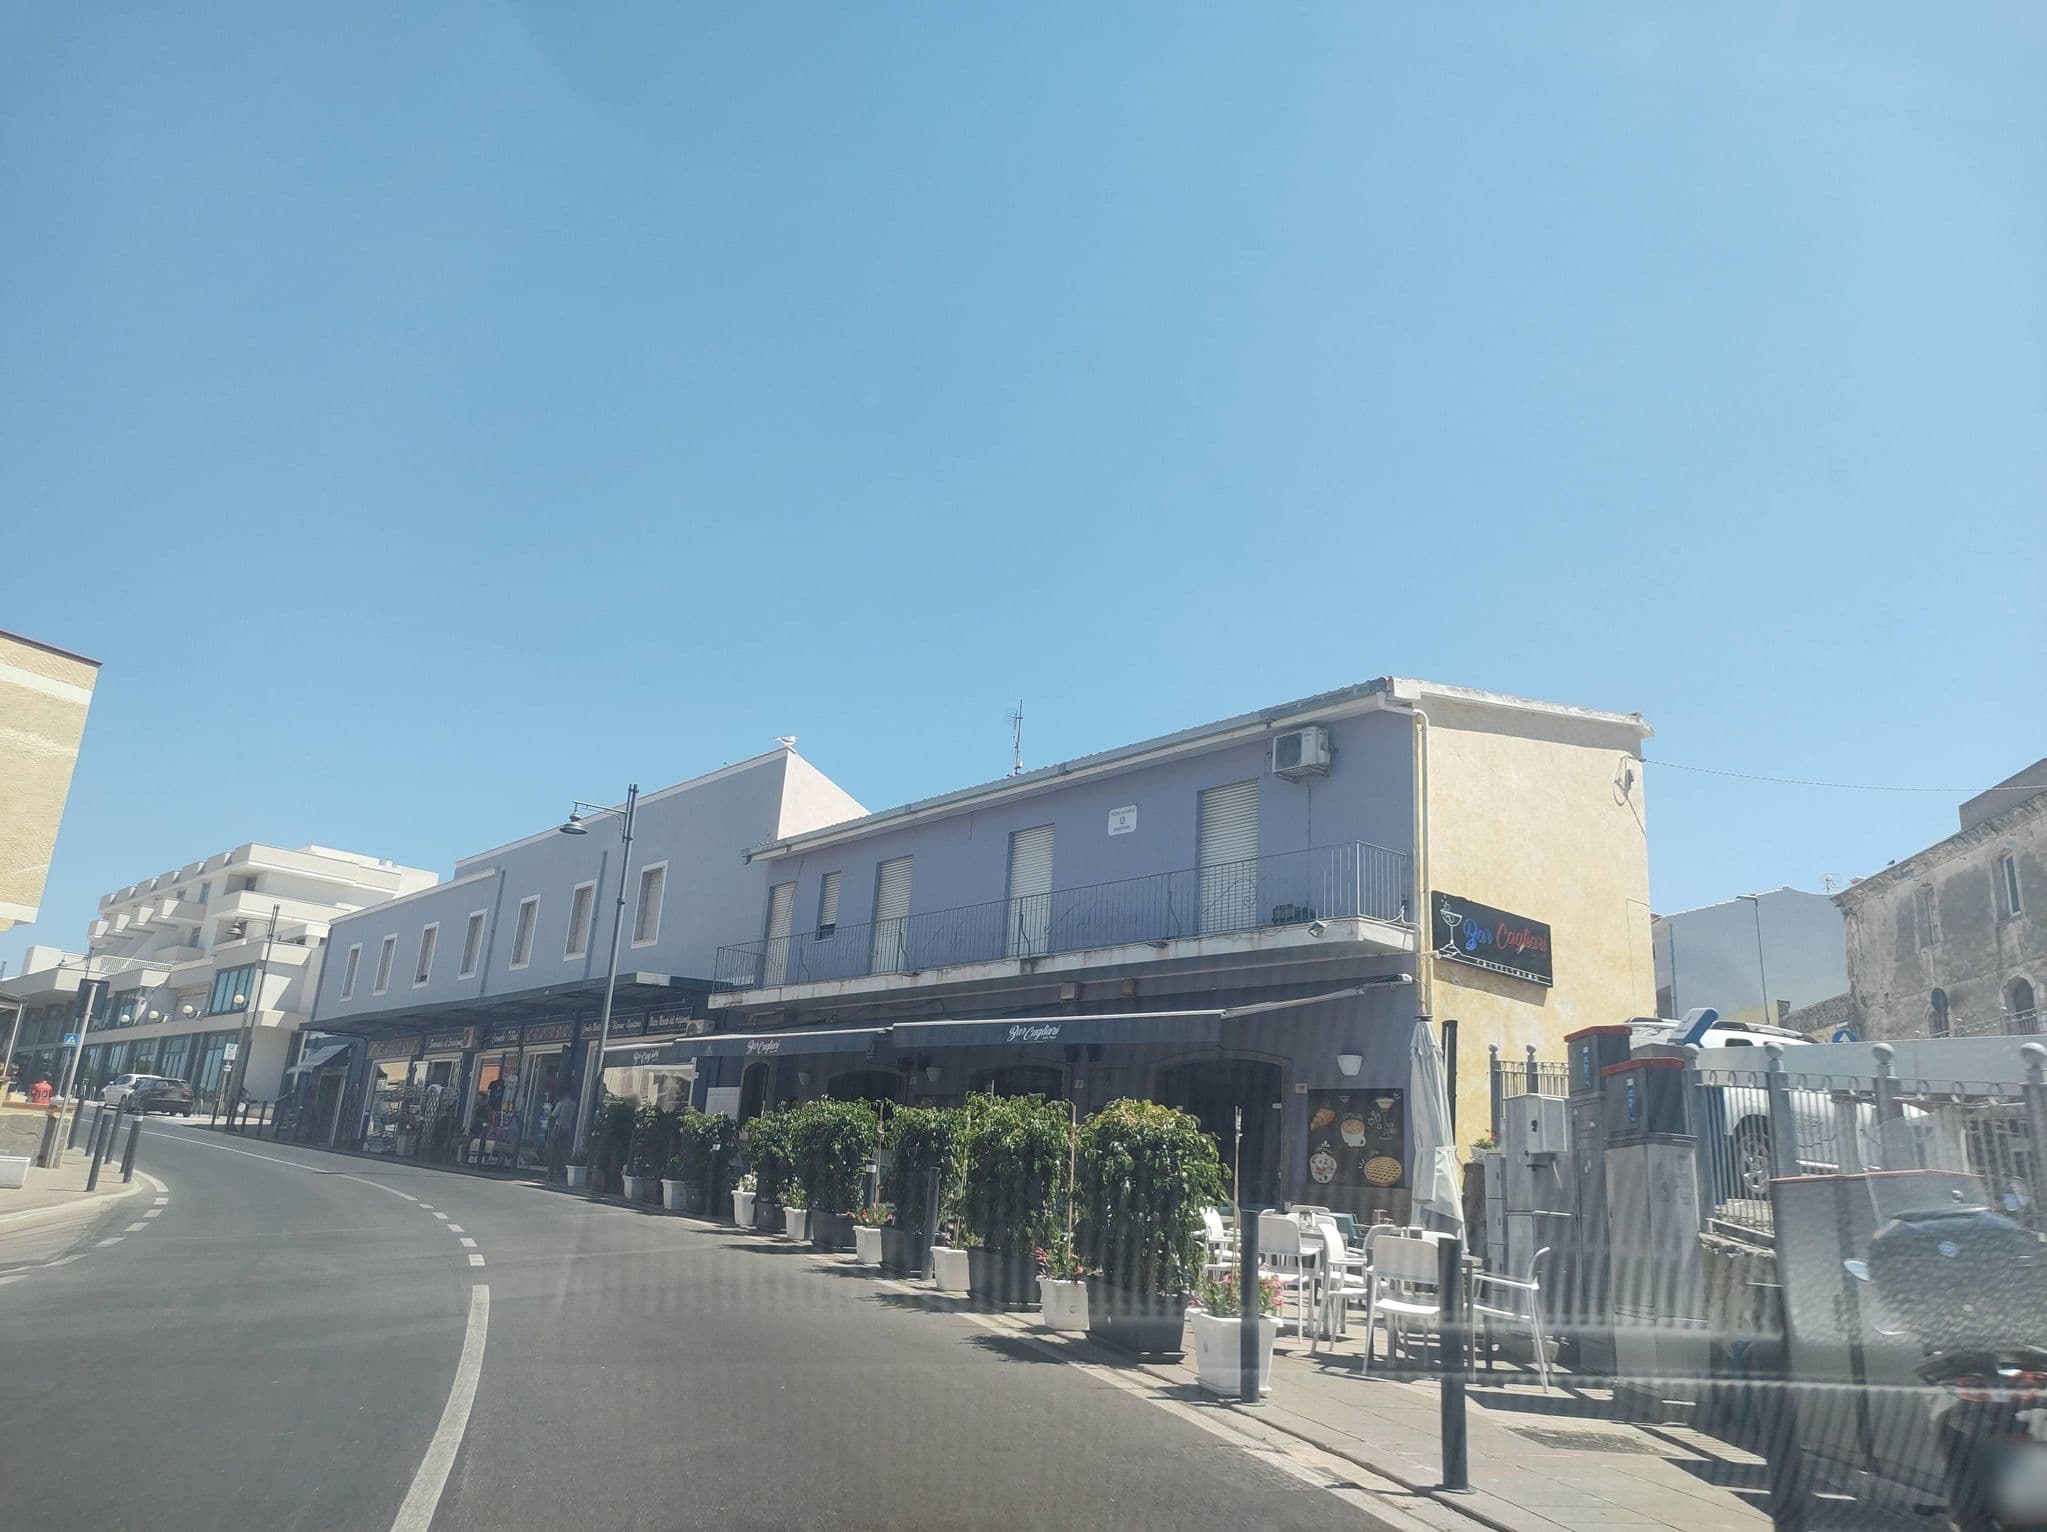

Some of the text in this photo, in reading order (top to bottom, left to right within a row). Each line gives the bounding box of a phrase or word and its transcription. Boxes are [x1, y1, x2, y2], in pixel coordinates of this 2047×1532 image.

[1463, 919, 1548, 954] Bar Cagliari
[1007, 1024, 1062, 1042] Bar Cagliari
